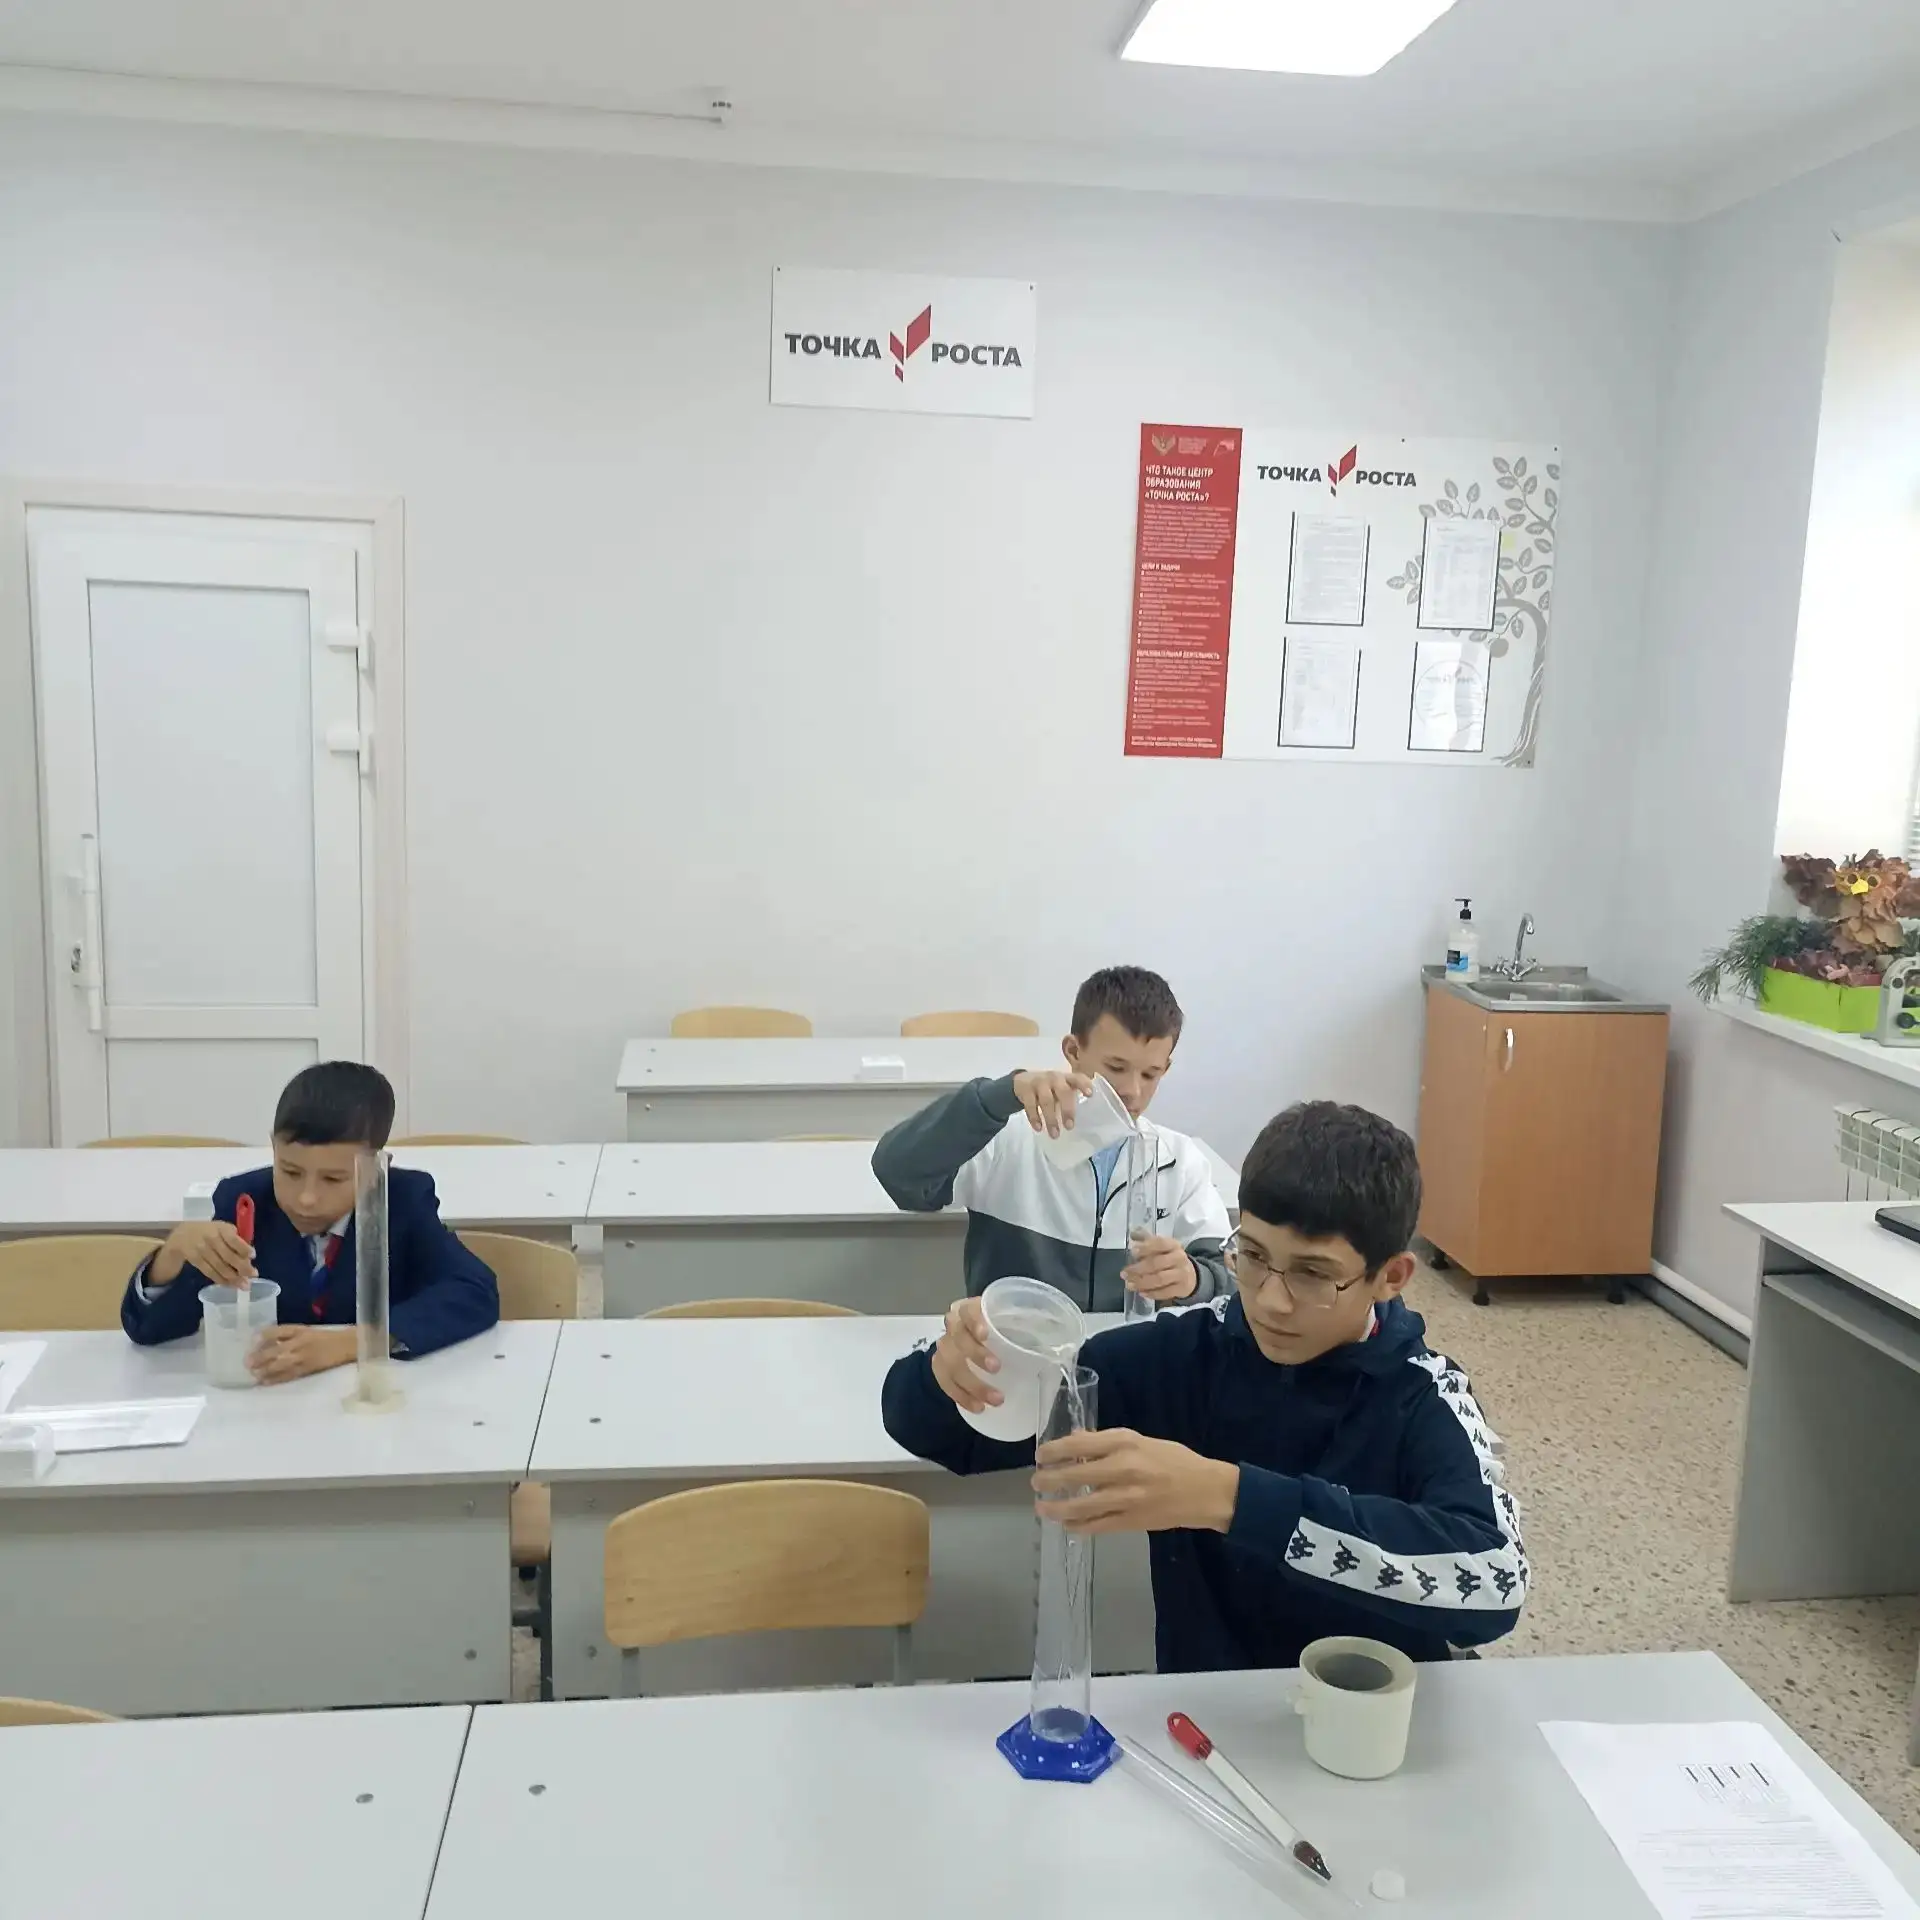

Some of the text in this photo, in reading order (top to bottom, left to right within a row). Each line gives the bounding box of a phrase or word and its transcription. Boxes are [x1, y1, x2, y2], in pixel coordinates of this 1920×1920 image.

[784, 332, 1022, 367] ТОЧКА РОСТА
[1145, 464, 1214, 479] ЧТО ТАКОЕ ЦЕНТР
[1257, 465, 1417, 487] ТОЧКА РОСТА
[1145, 476, 1202, 490] ОБРАЗОВАНИЯ
[1144, 489, 1175, 501] «ТОЧКА
